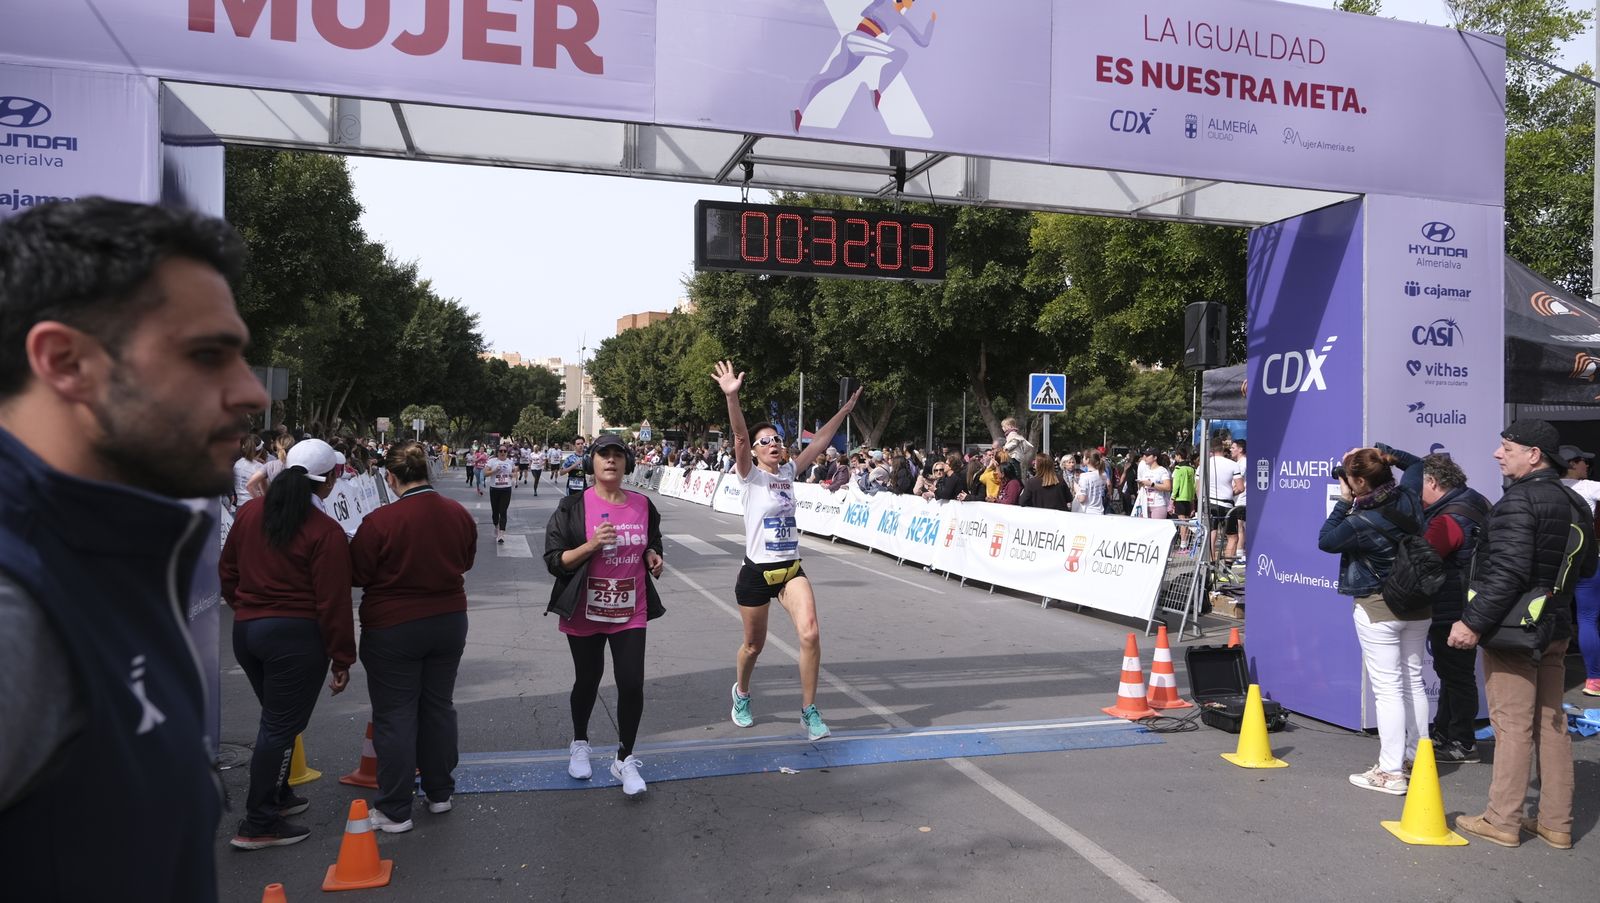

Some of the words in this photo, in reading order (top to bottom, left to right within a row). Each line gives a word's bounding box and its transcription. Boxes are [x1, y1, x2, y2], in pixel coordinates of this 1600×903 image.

[1144, 14, 1178, 45] LA
[1188, 20, 1326, 65] IGUALDAD
[1096, 55, 1134, 86] ES
[1142, 60, 1277, 105] NUESTRA
[1284, 80, 1368, 115] META.
[1208, 117, 1258, 136] ALMERÍA
[1207, 131, 1234, 142] CIUDAD
[741, 211, 934, 272] 00:32:03
[1408, 244, 1468, 259] HYUNDAI
[1424, 284, 1472, 299] cajamar
[1411, 325, 1454, 347] CASI
[1262, 336, 1338, 395] CDX
[1425, 362, 1468, 378] vithas
[1416, 410, 1467, 428] aqualia
[1279, 478, 1311, 490] CIUDAD
[774, 528, 791, 539] 201
[1012, 529, 1066, 552] ALMERÍA
[1009, 550, 1037, 563] CIUDAD
[1093, 539, 1160, 565] ALMERÍA
[1091, 562, 1125, 578] CIUDAD
[593, 590, 629, 604] 2579
